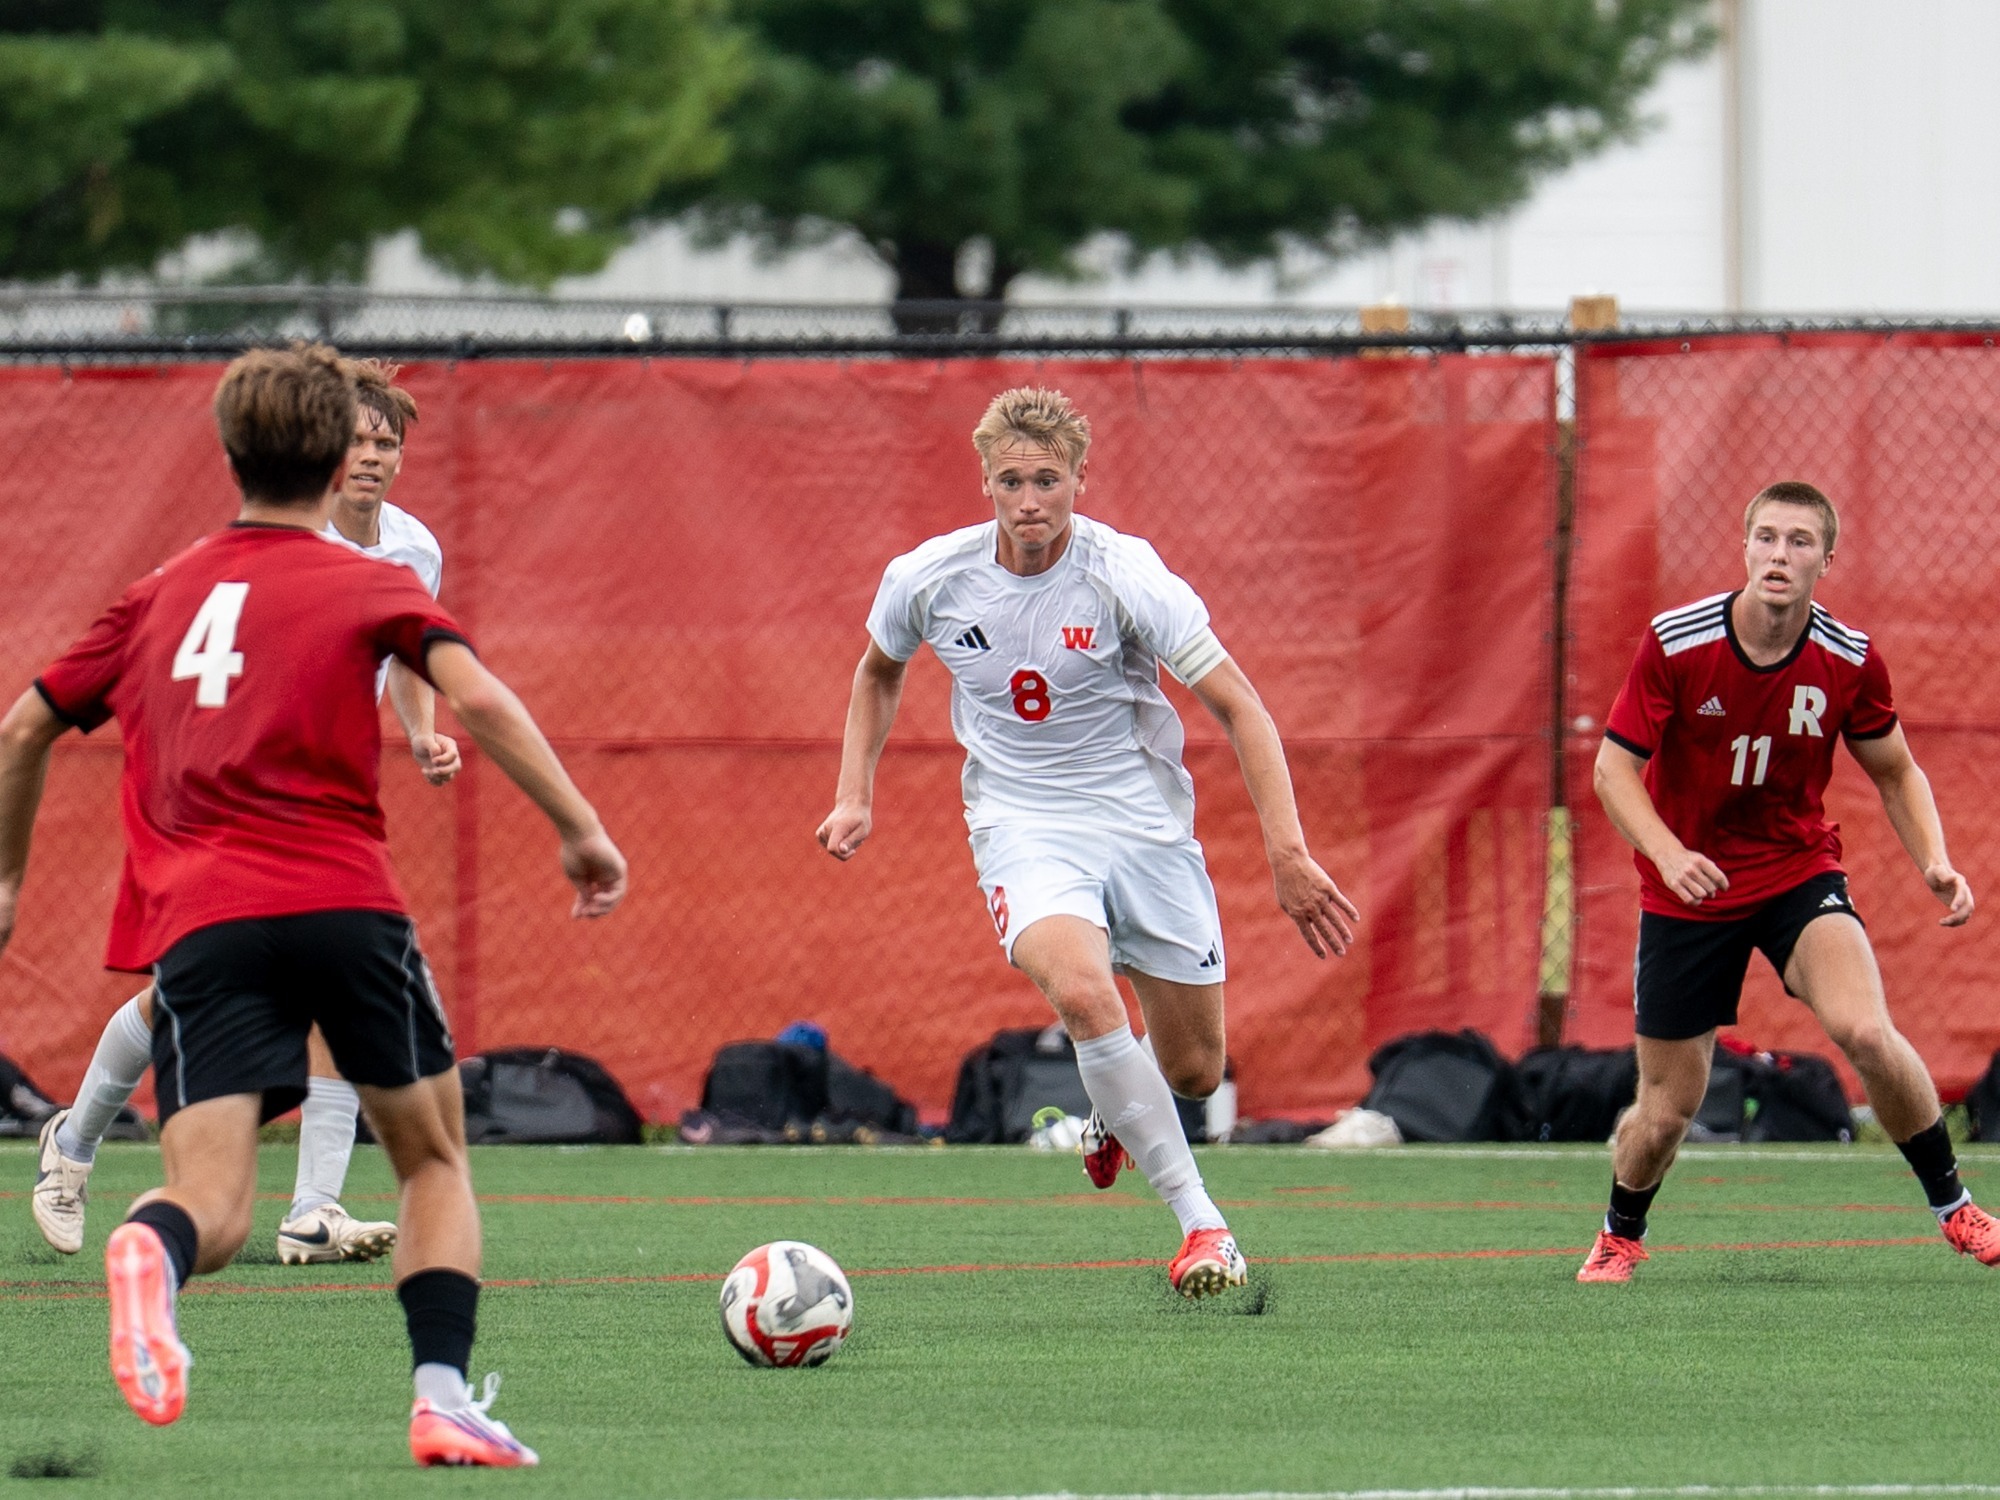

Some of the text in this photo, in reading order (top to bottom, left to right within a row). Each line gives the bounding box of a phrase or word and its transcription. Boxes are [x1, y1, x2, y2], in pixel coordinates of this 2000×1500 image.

[171, 581, 250, 707] 4
[1010, 669, 1051, 721] 8
[1696, 708, 1726, 717] adidas
[1788, 685, 1828, 738] R
[1730, 734, 1772, 786] 11
